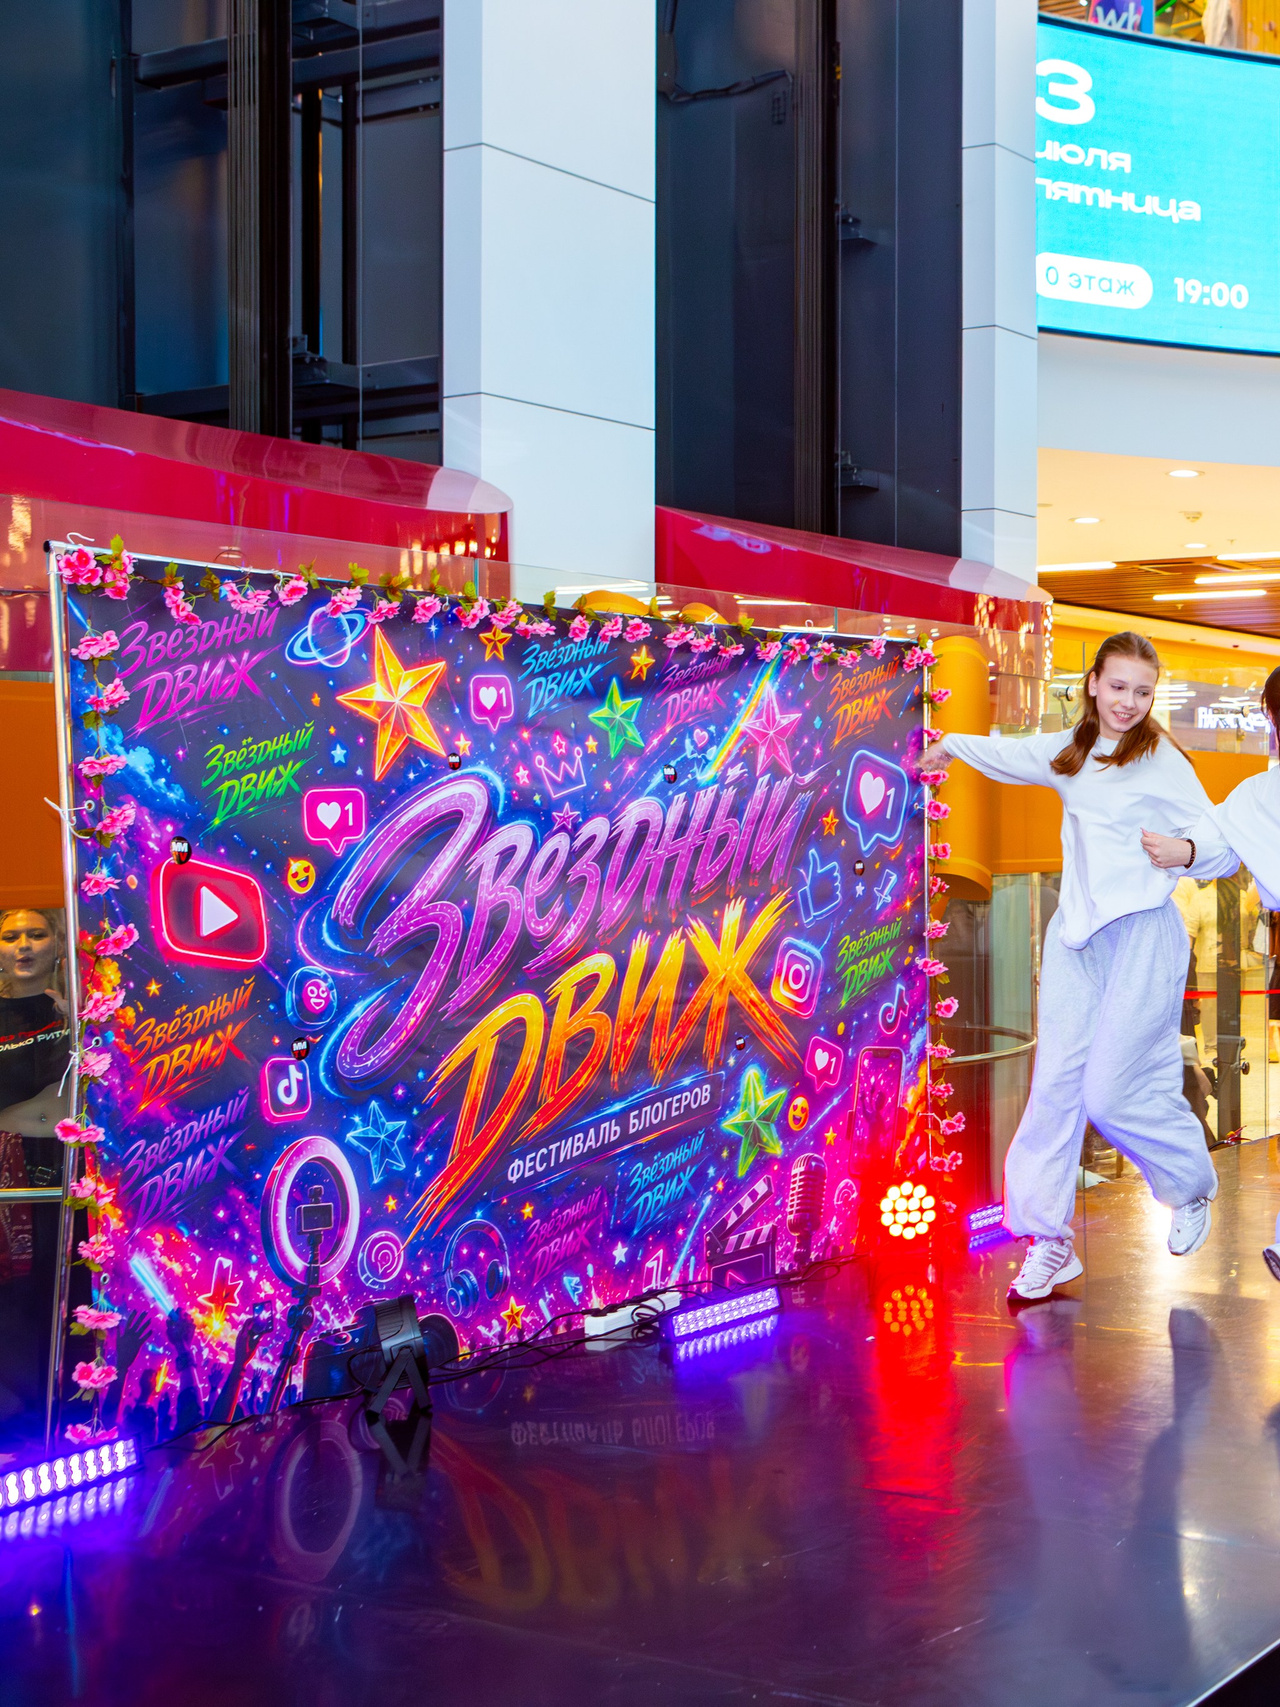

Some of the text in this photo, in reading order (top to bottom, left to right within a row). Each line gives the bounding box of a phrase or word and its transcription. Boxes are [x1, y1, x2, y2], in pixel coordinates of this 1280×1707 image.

[1036, 59, 1095, 125] 3
[1045, 266, 1135, 296] 0 этаж
[1174, 277, 1249, 309] 19:00
[507, 1084, 711, 1184] ФЕСТИВАЛЬ БЛОГЕРОВ
